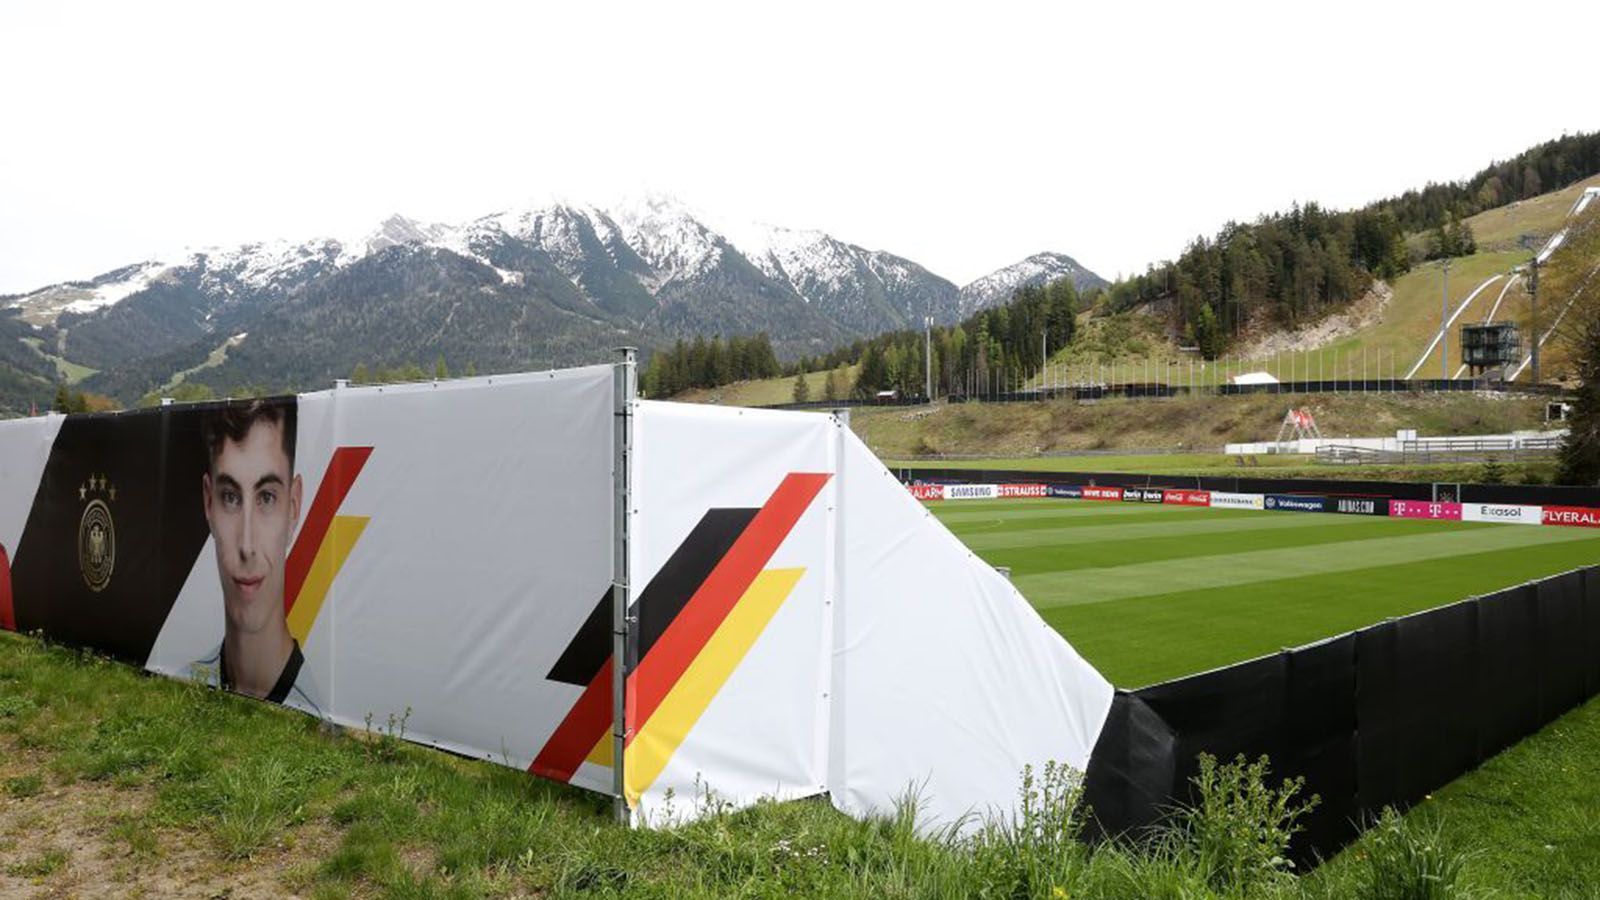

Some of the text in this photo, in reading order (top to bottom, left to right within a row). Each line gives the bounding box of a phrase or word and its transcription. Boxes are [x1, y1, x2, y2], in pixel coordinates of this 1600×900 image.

[951, 488, 991, 497] SAMSUNG
[1005, 487, 1039, 496] STRAUSS
[1278, 500, 1323, 511] Volkswagen
[1338, 499, 1375, 514] ADIDAS.COM
[1481, 505, 1521, 517] Exasol
[1542, 510, 1600, 524] FLYERAL
